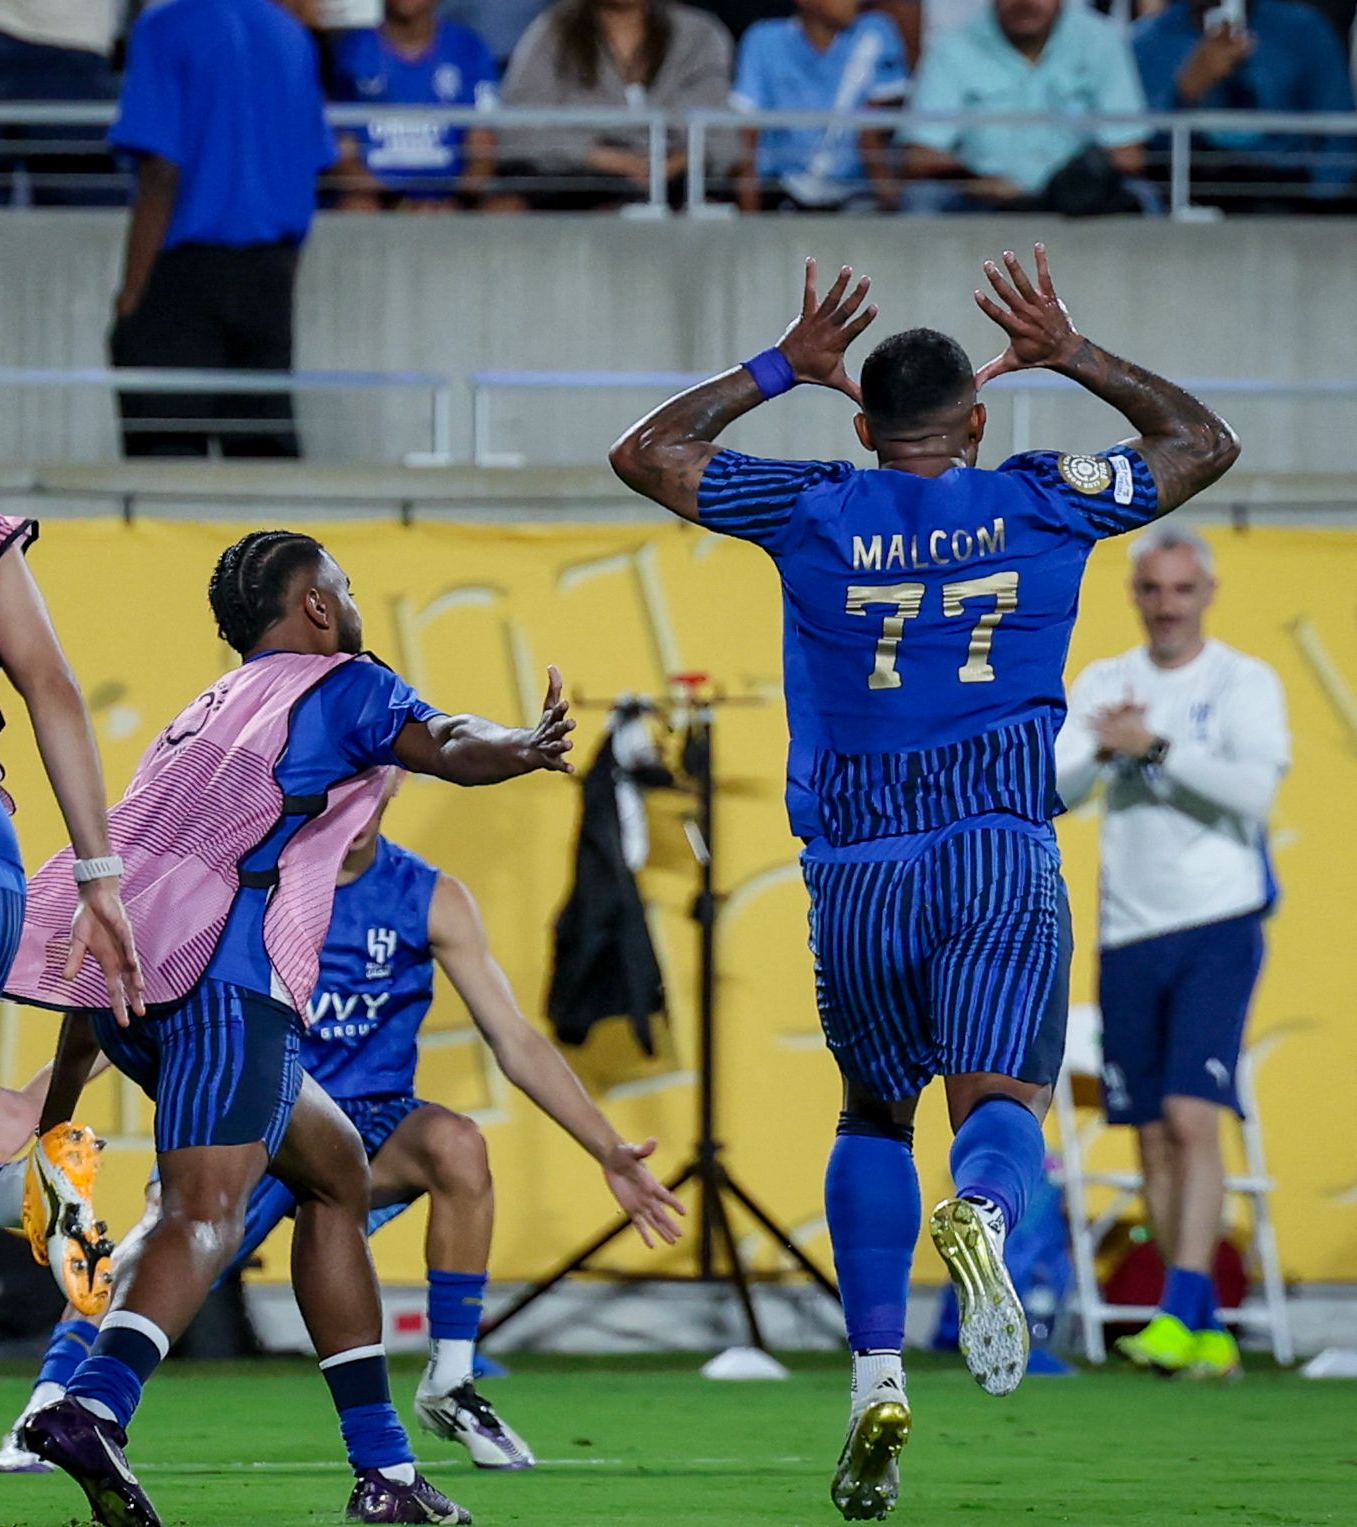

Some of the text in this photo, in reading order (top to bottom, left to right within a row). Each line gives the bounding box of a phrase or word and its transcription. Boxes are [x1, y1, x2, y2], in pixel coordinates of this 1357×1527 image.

[852, 517, 1005, 571] MALCOM
[845, 571, 1019, 690] 77
[305, 991, 390, 1025] VVY
